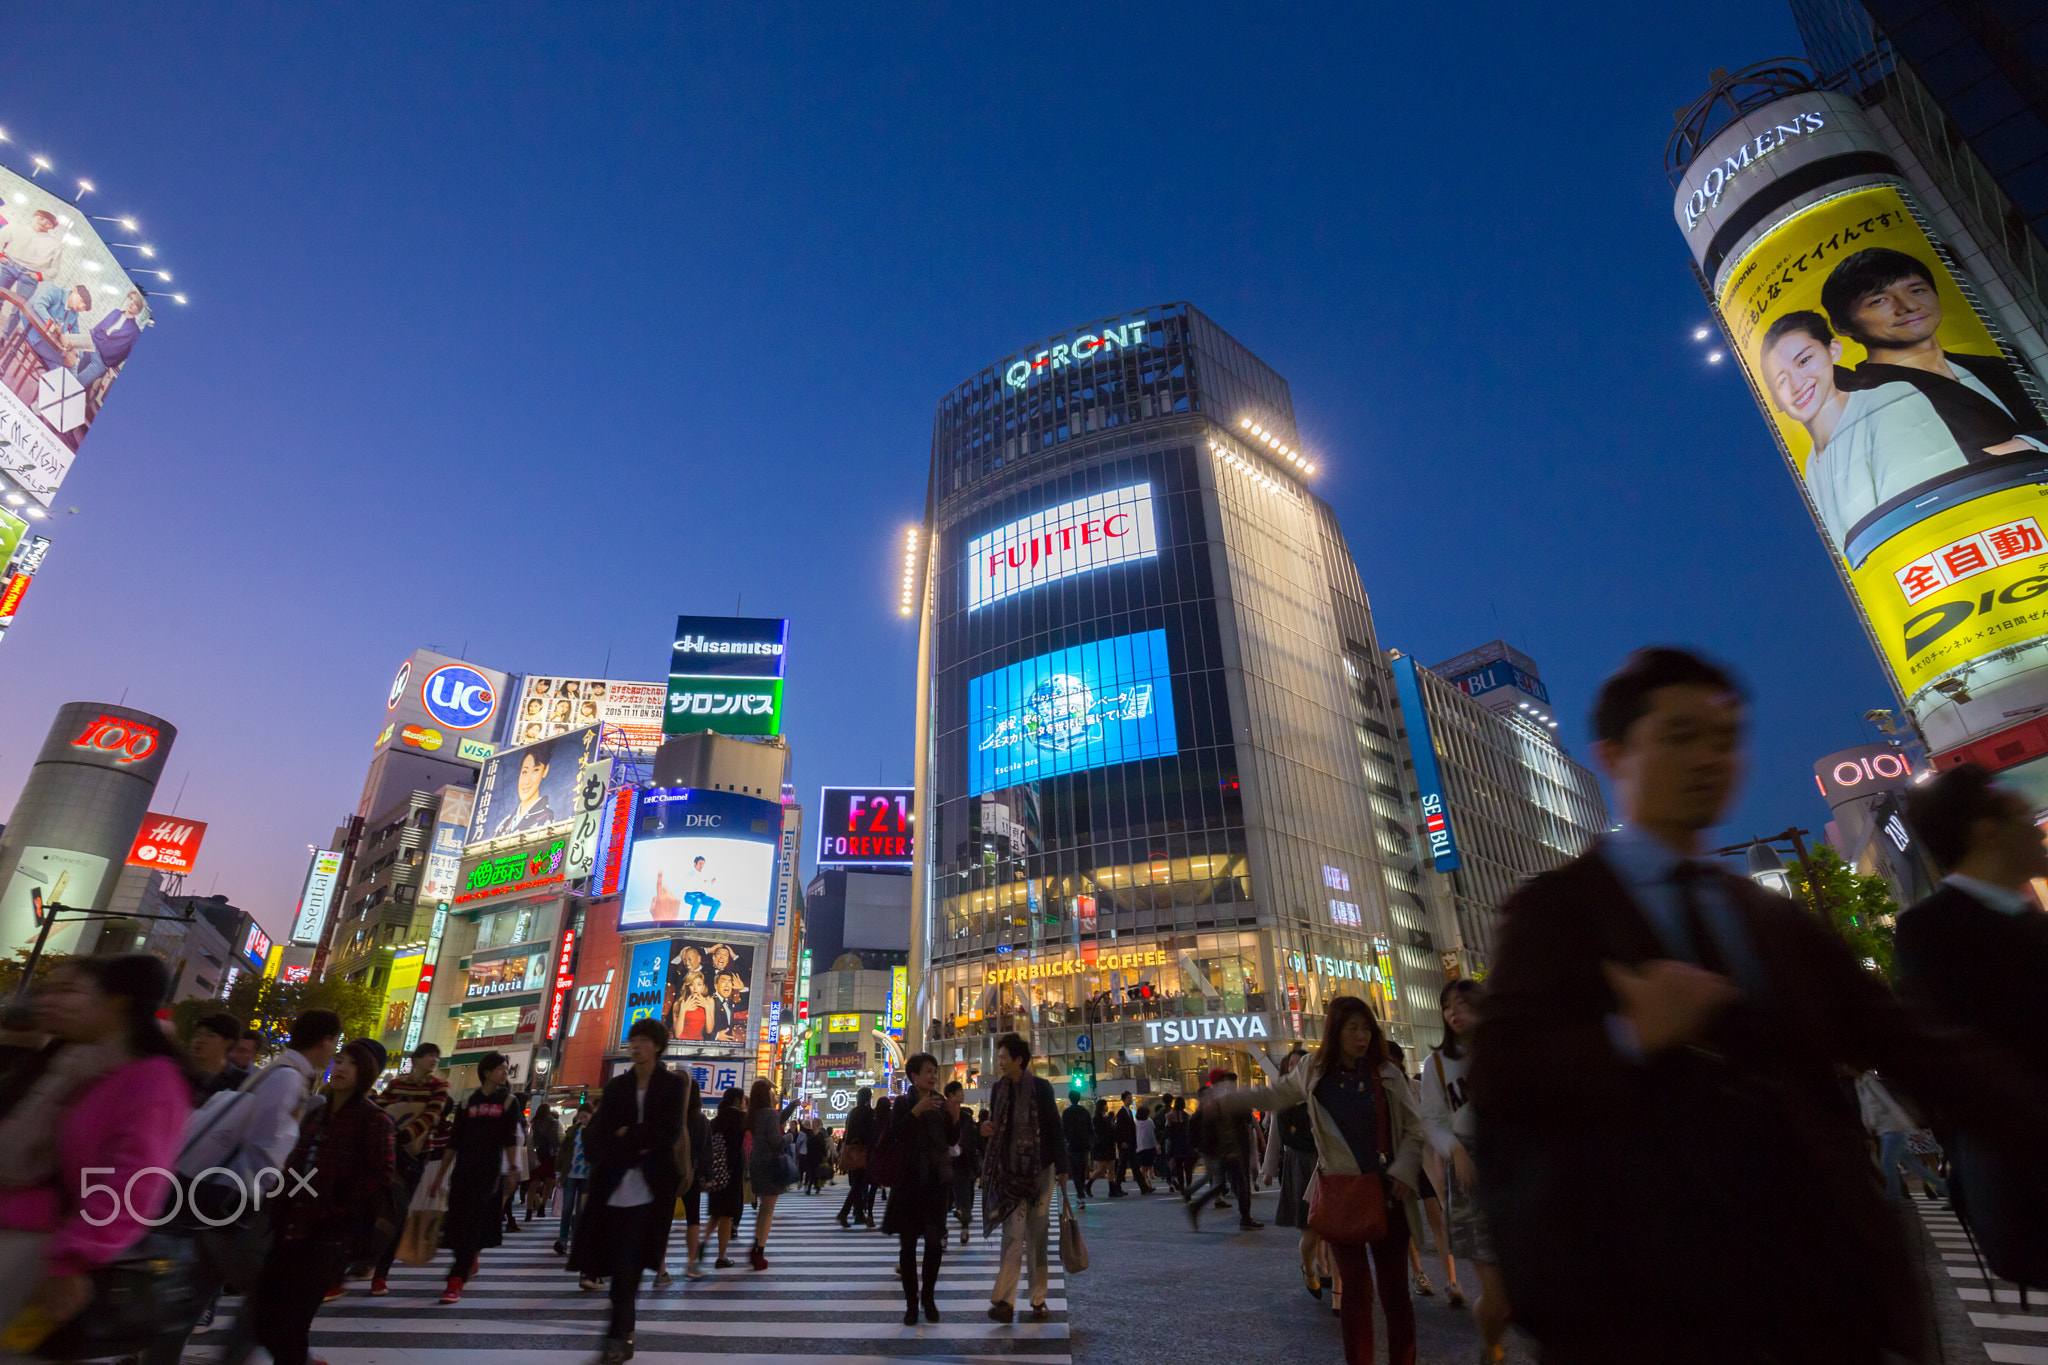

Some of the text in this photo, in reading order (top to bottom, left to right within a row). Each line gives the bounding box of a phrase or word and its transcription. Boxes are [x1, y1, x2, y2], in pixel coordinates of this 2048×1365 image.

[1724, 262, 1758, 312] Panasonic
[988, 513, 1130, 578] FUJITEC
[1901, 524, 2044, 600] 全自動
[672, 635, 784, 656] Hisamitsu
[669, 692, 774, 715] サロンパス
[98, 715, 159, 737] SHIBUYA
[401, 729, 443, 747] MasterCard
[70, 721, 158, 763] 109
[464, 745, 492, 758] VISA
[994, 757, 1039, 775] Escalaors
[659, 793, 688, 802] Channel
[569, 773, 606, 873] もんじゃ
[685, 814, 722, 828] DHC
[848, 795, 906, 832] F21
[1421, 793, 1452, 859] SEIBU
[148, 821, 194, 846] H&M
[823, 836, 906, 856] FOREVER
[156, 854, 187, 867] 150m
[777, 825, 796, 927] Taisei neon
[296, 872, 330, 940] Essential
[987, 950, 1167, 985] STARBUCKS COFFEE
[1314, 956, 1384, 985] TSUTAYA
[467, 979, 522, 997] Euphoria
[628, 989, 662, 1008] DMM
[1146, 1016, 1268, 1044] TSUTAYA
